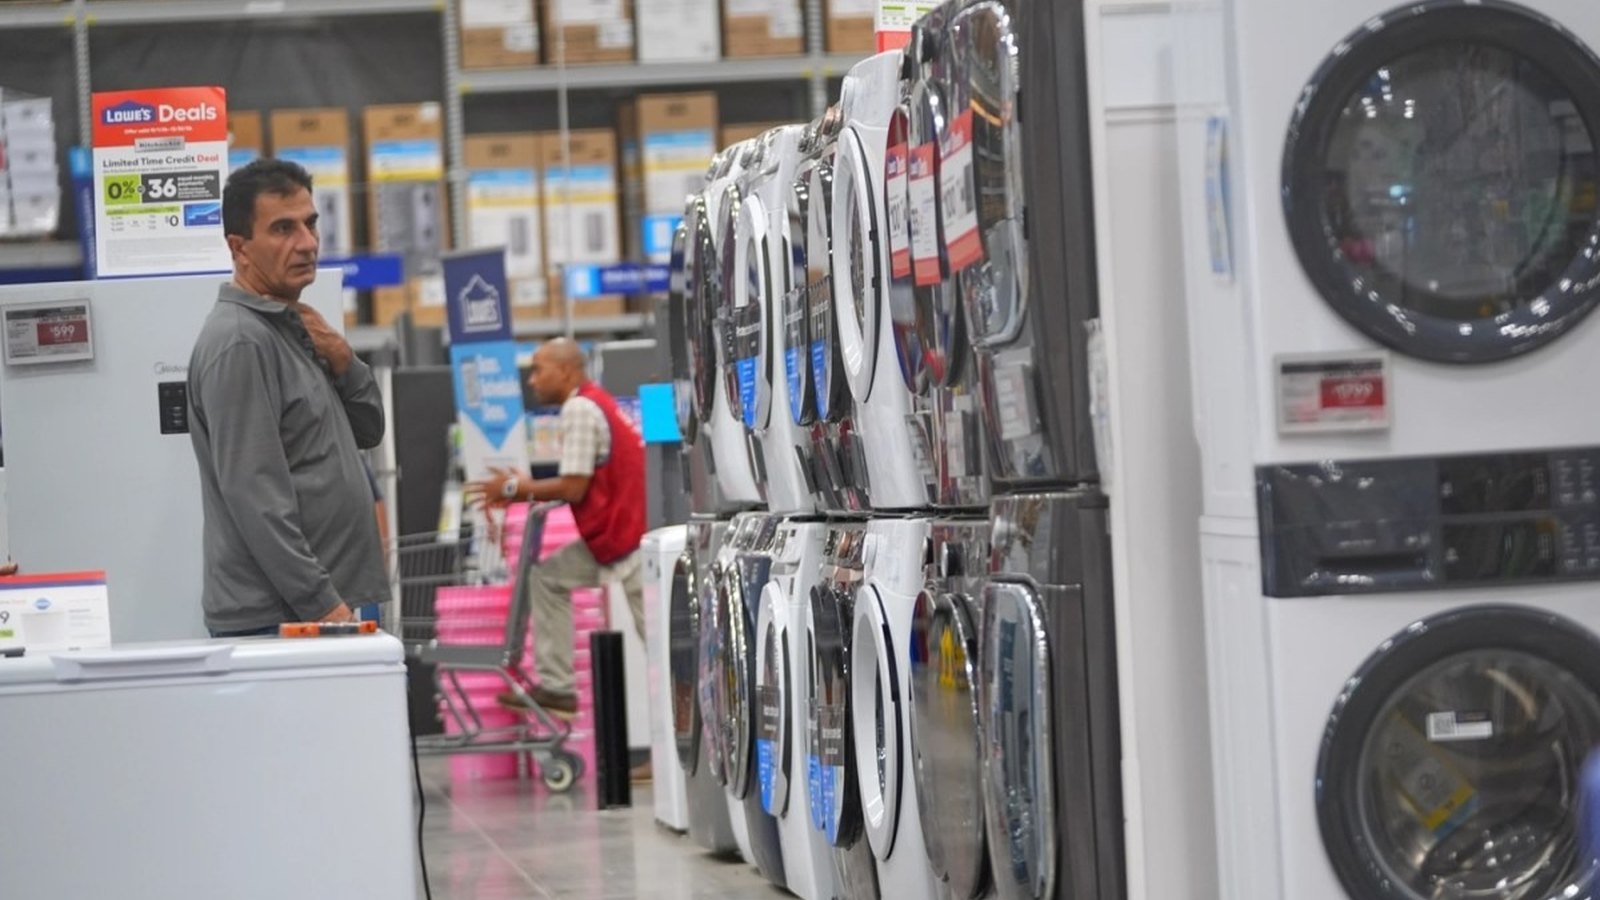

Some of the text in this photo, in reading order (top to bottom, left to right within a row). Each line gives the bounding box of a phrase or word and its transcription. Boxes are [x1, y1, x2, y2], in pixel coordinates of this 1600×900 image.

[106, 103, 217, 122] LOWE'S Deals
[102, 154, 219, 168] Limited Time Credit Deal
[108, 180, 135, 199] 0%
[148, 178, 177, 198] 36
